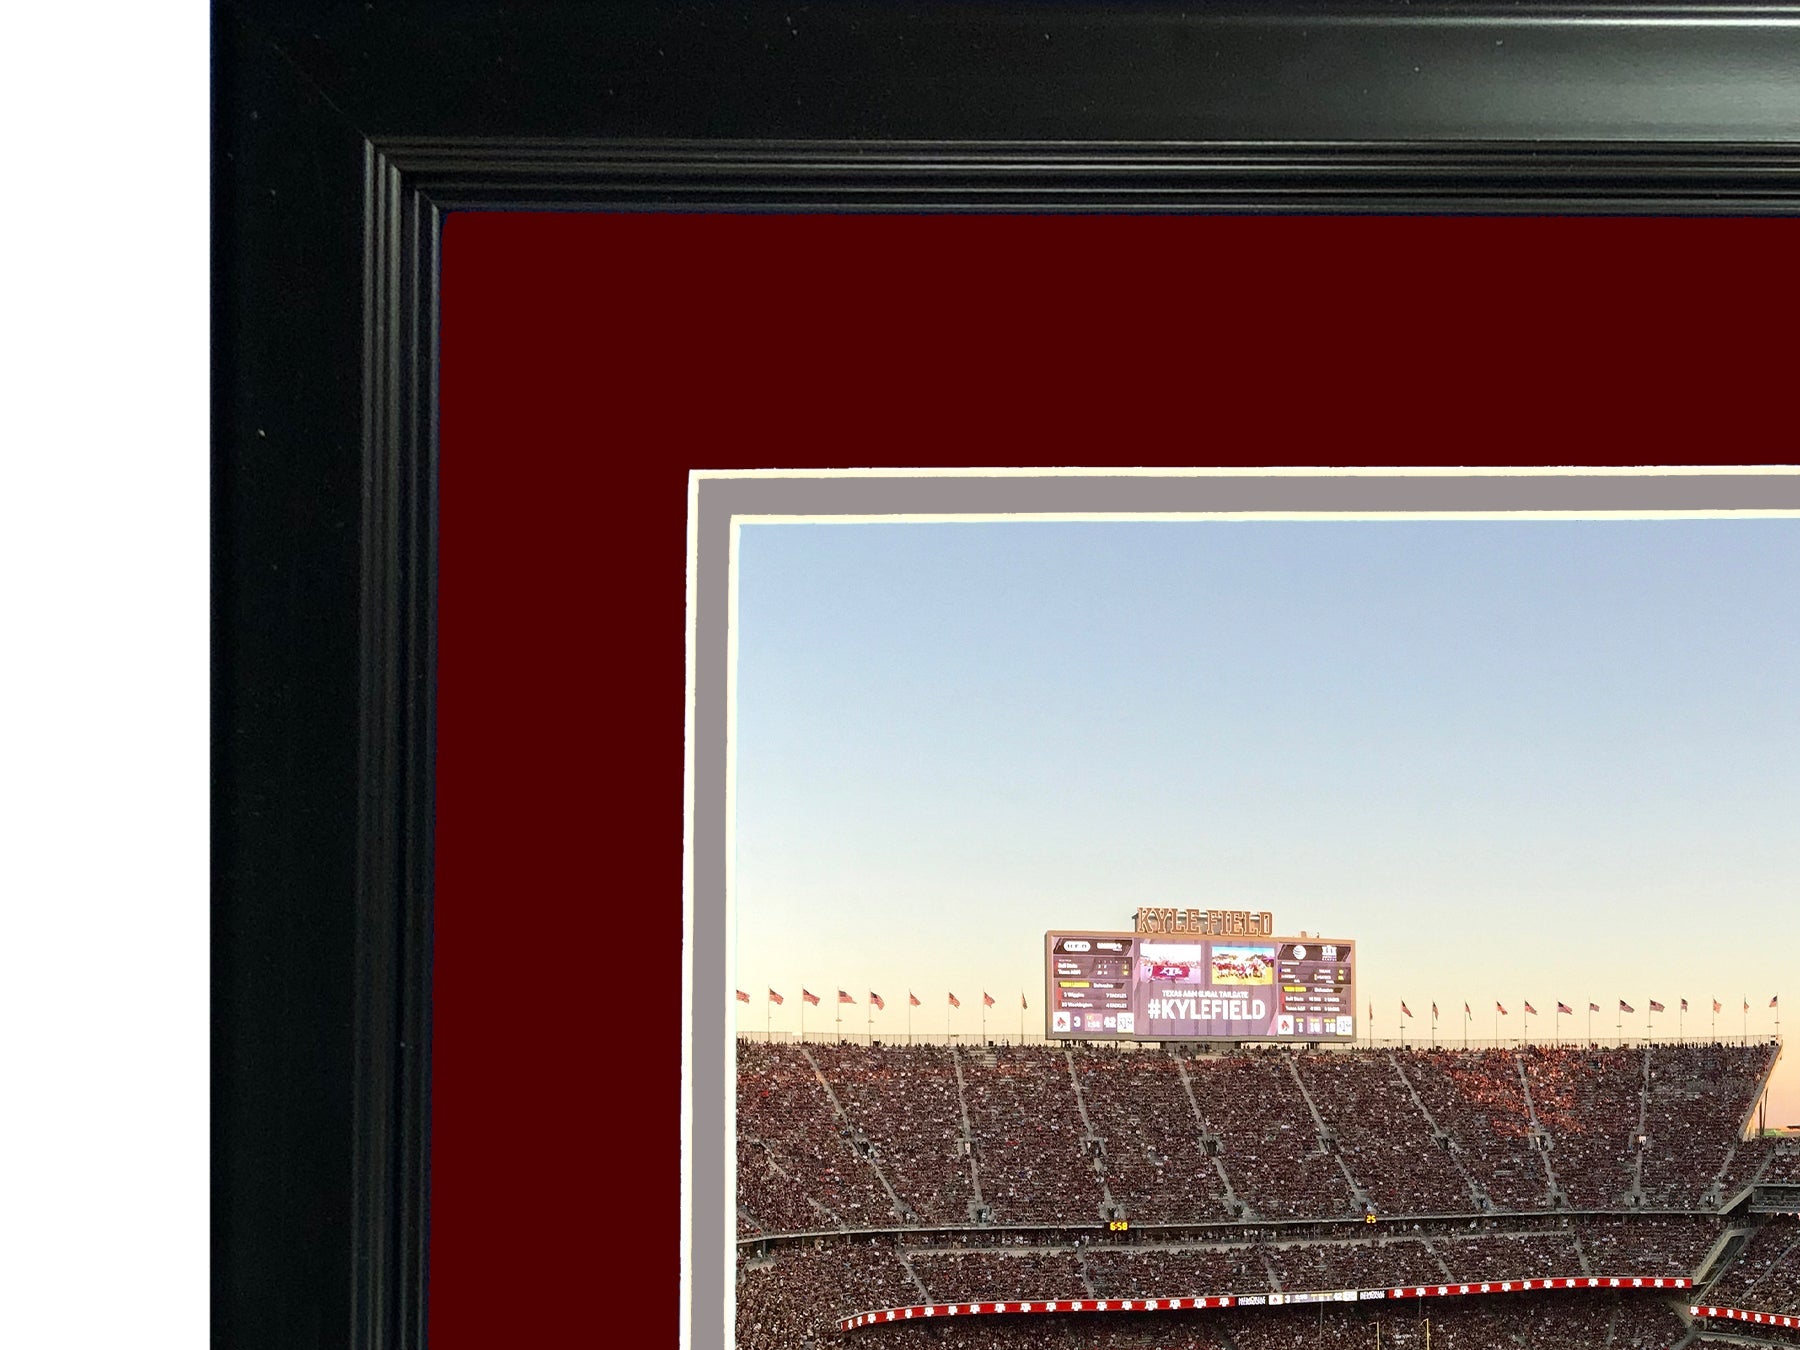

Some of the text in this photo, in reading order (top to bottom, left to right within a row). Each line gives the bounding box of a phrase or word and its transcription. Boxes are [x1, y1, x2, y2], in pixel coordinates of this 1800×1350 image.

[1138, 907, 1273, 937] KYLE FIELD
[1148, 999, 1265, 1020] #KYLEFIELD
[1073, 1016, 1081, 1027] 3
[1103, 1016, 1116, 1028] 42
[1366, 1215, 1376, 1223] 25
